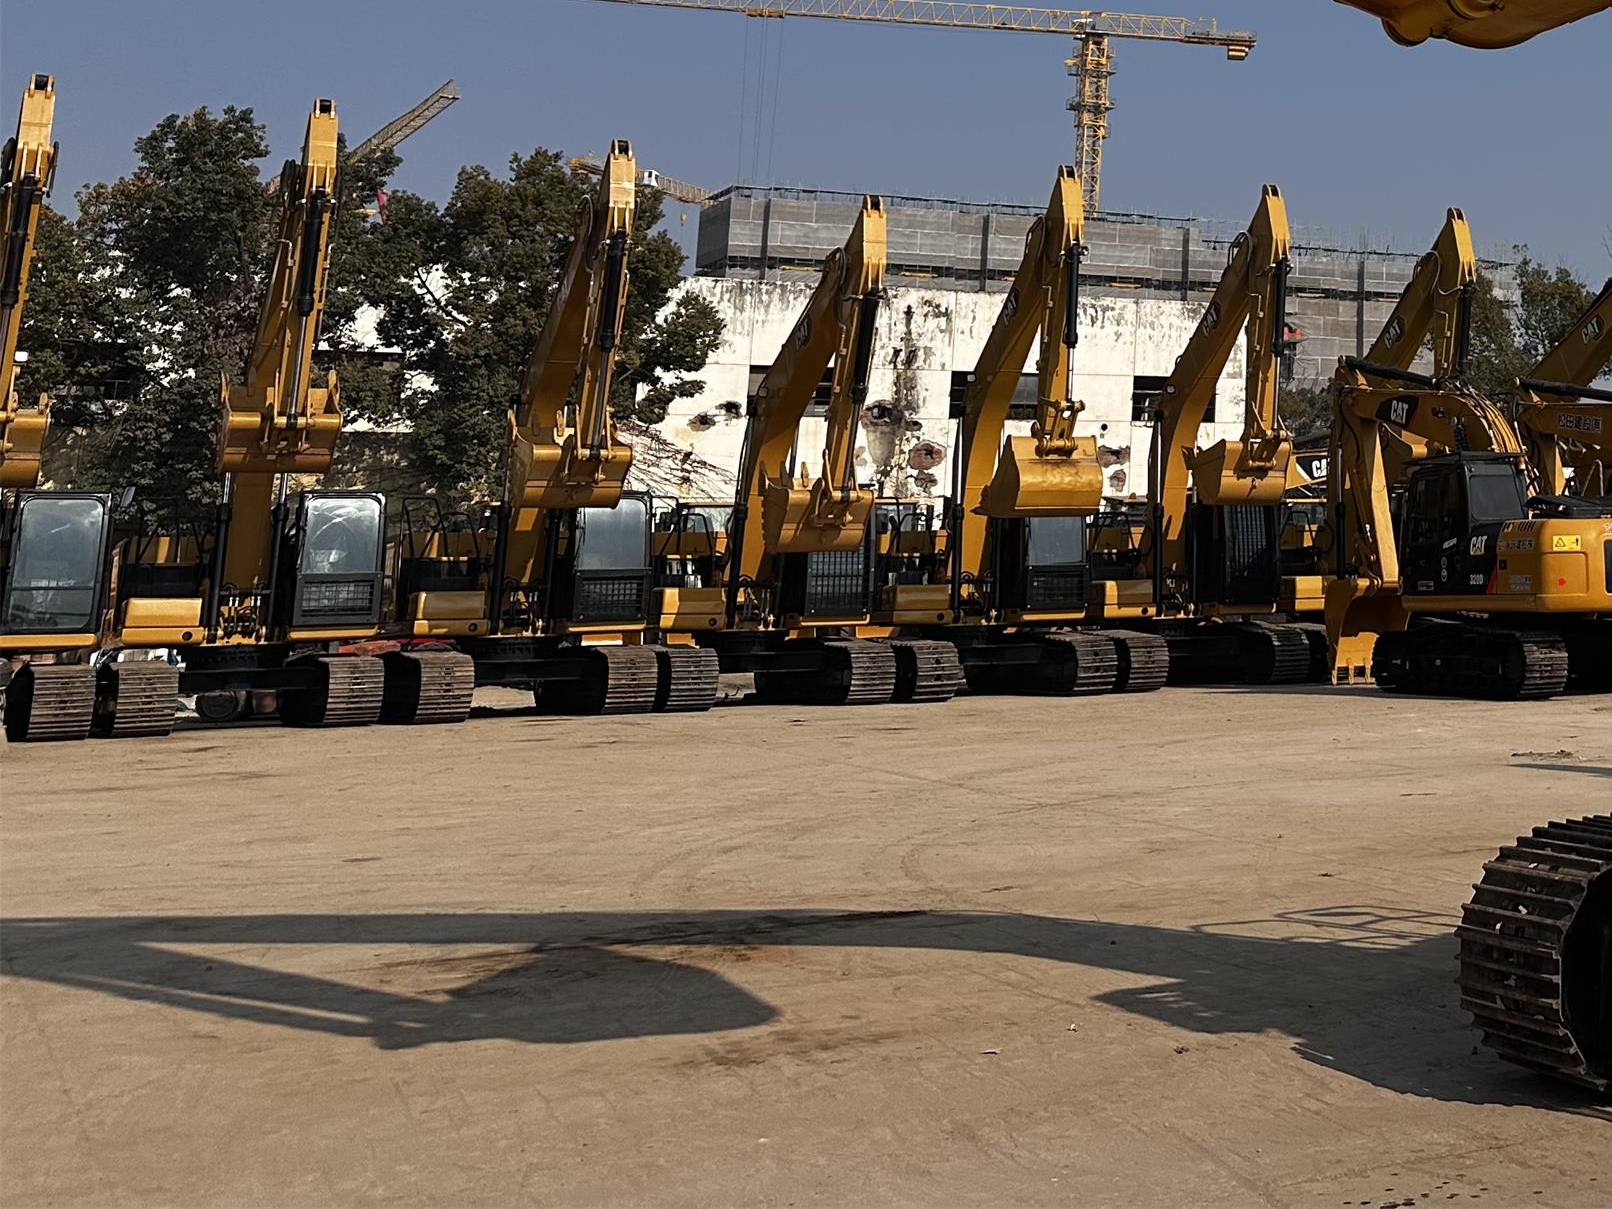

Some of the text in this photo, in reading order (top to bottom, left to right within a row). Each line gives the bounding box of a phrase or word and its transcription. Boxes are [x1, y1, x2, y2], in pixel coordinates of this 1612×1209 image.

[1202, 308, 1219, 337] CAT
[1384, 320, 1401, 350] CAT
[1582, 317, 1600, 343] CAT
[1390, 399, 1409, 424] CAT
[1312, 460, 1328, 478] CA
[1470, 535, 1488, 556] CAT
